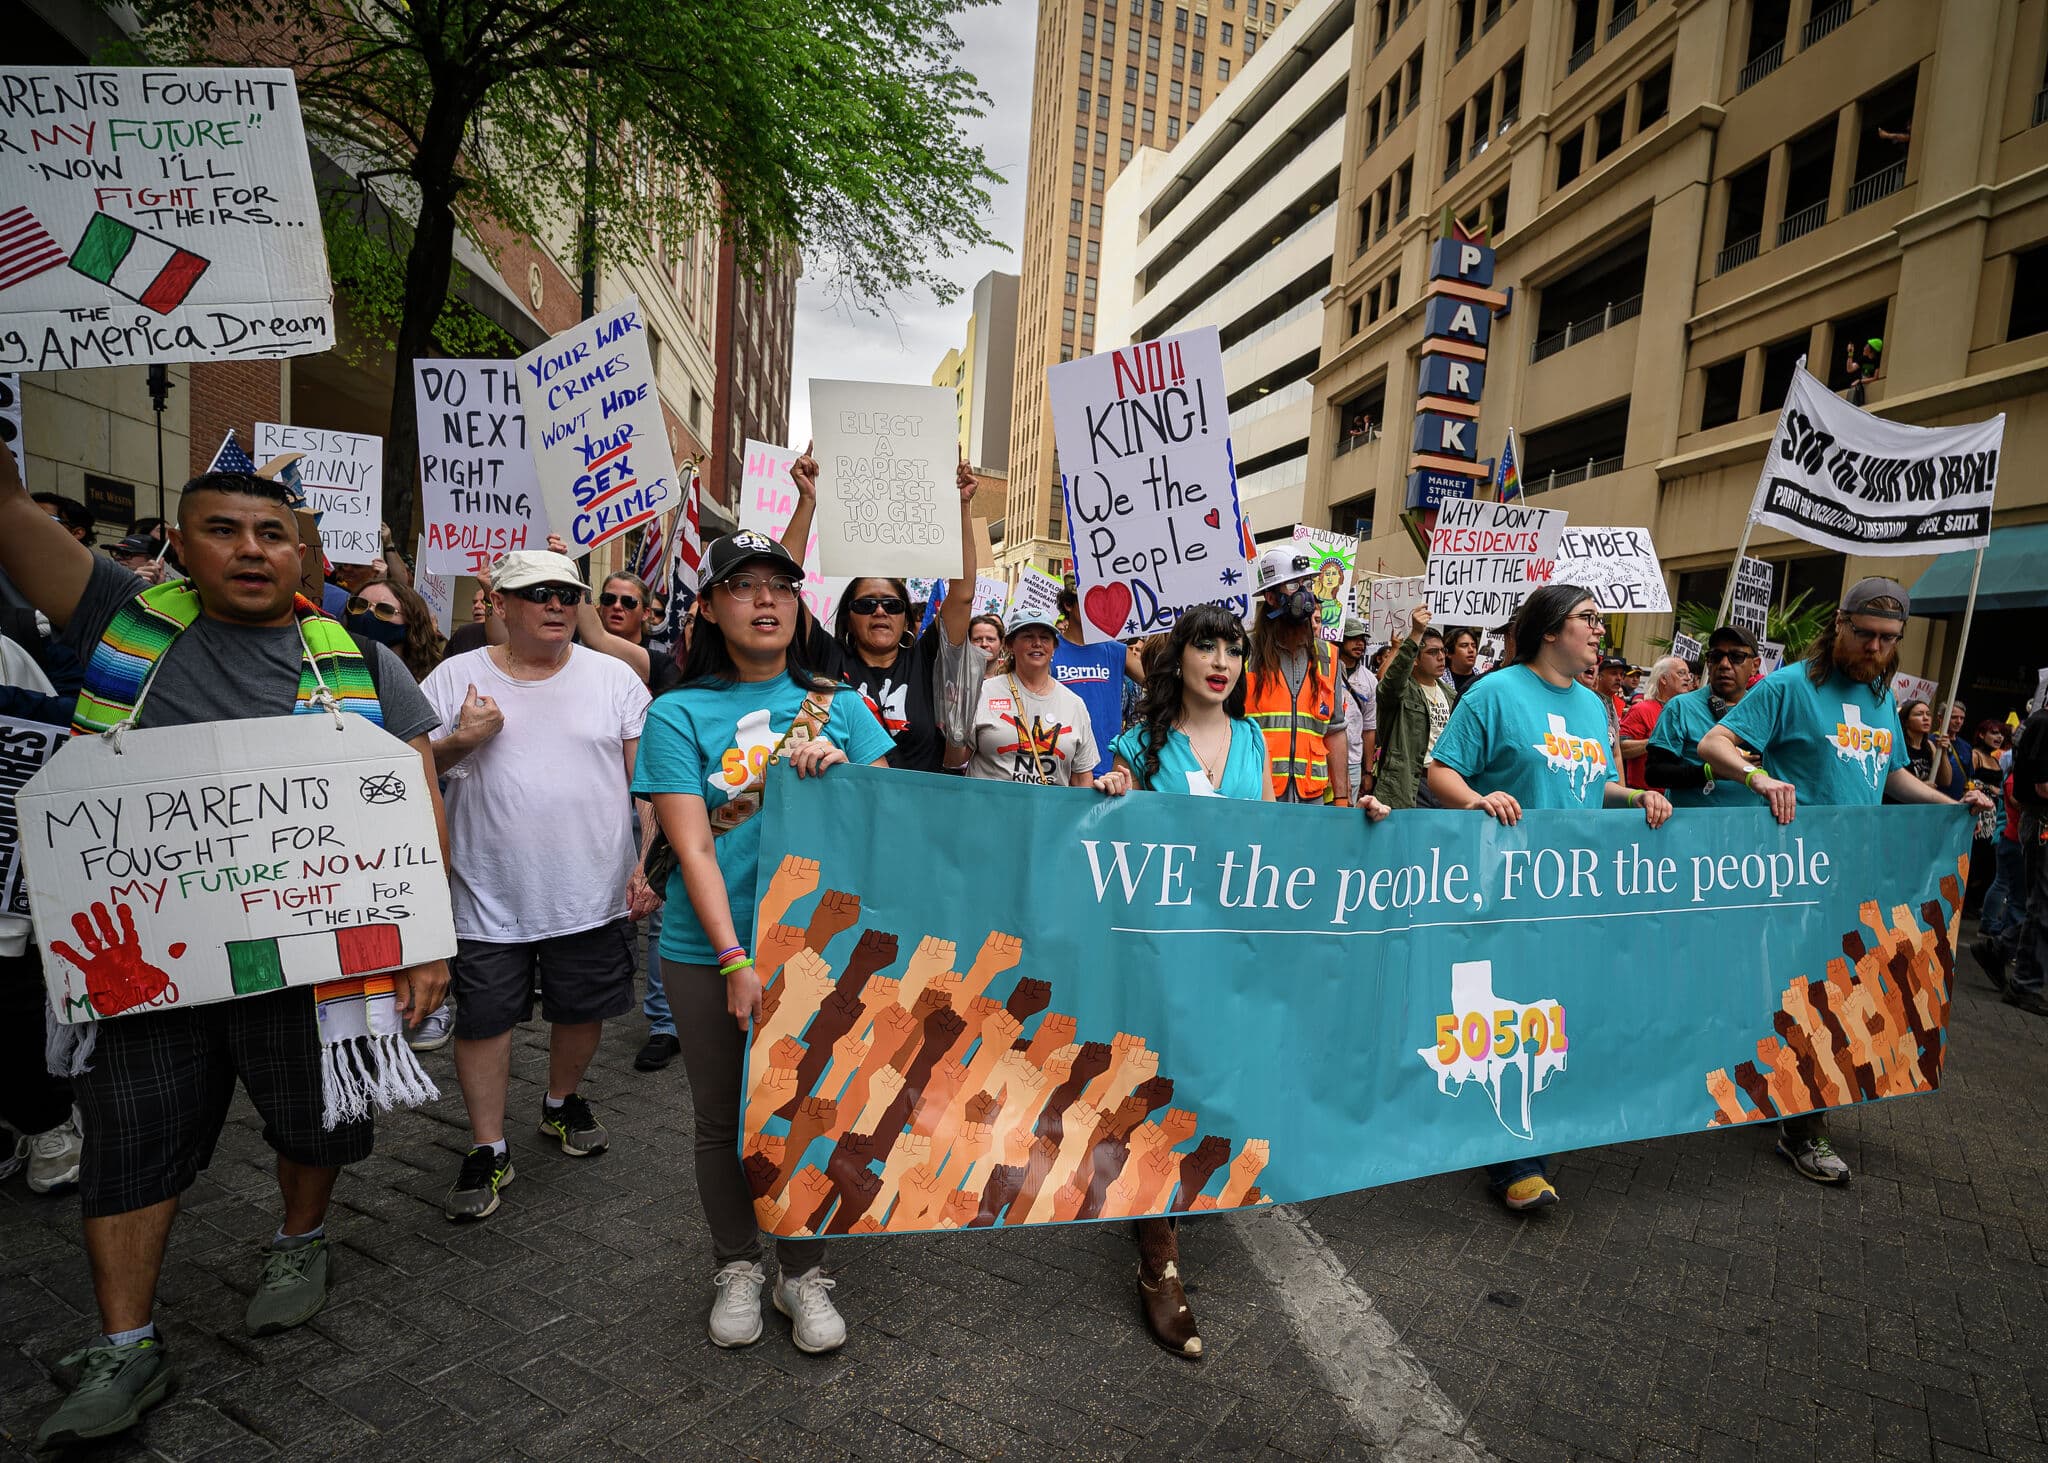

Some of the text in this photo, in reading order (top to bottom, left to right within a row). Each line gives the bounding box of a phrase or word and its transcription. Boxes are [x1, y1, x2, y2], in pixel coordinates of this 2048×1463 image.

[143, 73, 287, 110] FOUGHT
[31, 121, 96, 155] MY
[160, 153, 235, 180] I'LL
[94, 186, 279, 211] FIGHT FOR
[60, 307, 111, 322] THE
[207, 312, 326, 344] Dream
[527, 311, 642, 388] YOUR WAR
[1443, 245, 1482, 451] PARK
[548, 353, 630, 411] CRIMES
[1112, 340, 1186, 400] NO!!
[421, 368, 467, 407] DO
[541, 383, 648, 450] WON'T HIDE
[840, 411, 923, 437] ELECT
[1086, 378, 1208, 465] KING!
[265, 425, 370, 456] RESIST
[573, 423, 645, 467] YOUR
[874, 436, 894, 456] A
[259, 454, 373, 491] TRANNY
[423, 455, 504, 488] RIGHT
[572, 456, 634, 507] SEX
[836, 456, 929, 480] RAPIST
[1428, 477, 1467, 488] MARKET
[303, 492, 371, 516] INGS!
[450, 489, 532, 519] THING
[835, 478, 936, 501] EXPECT
[1073, 455, 1208, 524] We the
[1429, 487, 1464, 498] STREET
[572, 478, 668, 545] CRIMES
[845, 500, 937, 523] TO GET
[1442, 500, 1549, 529] WHY DON'T
[428, 523, 528, 551] ABOLISH
[843, 521, 945, 545] FUCKED
[1312, 529, 1335, 544] HOLD
[1336, 536, 1358, 548] MY
[1432, 528, 1538, 553] PRESIDENTS
[1089, 517, 1208, 594] People
[1752, 560, 1772, 581] DON'T
[1429, 558, 1488, 585] FIGHT
[1489, 559, 1525, 583] THE
[1526, 558, 1555, 582] WAR
[1737, 574, 1771, 588] WANT AN
[1424, 590, 1463, 614] THEY
[1464, 591, 1501, 615] SEND
[1735, 582, 1770, 607] EMPIRE!
[1056, 664, 1110, 680] Bernie
[1544, 732, 1607, 766] 50501
[1837, 723, 1892, 754] 50501
[1014, 756, 1057, 776] NO
[46, 777, 330, 848] MY PARENTS
[81, 825, 345, 880] FOUGHT FOR
[110, 878, 168, 914] MY
[178, 860, 290, 899] FUTURE
[394, 843, 437, 868] I'LL
[1080, 837, 1831, 925] WE the people, FOR the people
[240, 881, 414, 913] FIGHT FOR
[1436, 1005, 1569, 1065] 50501
